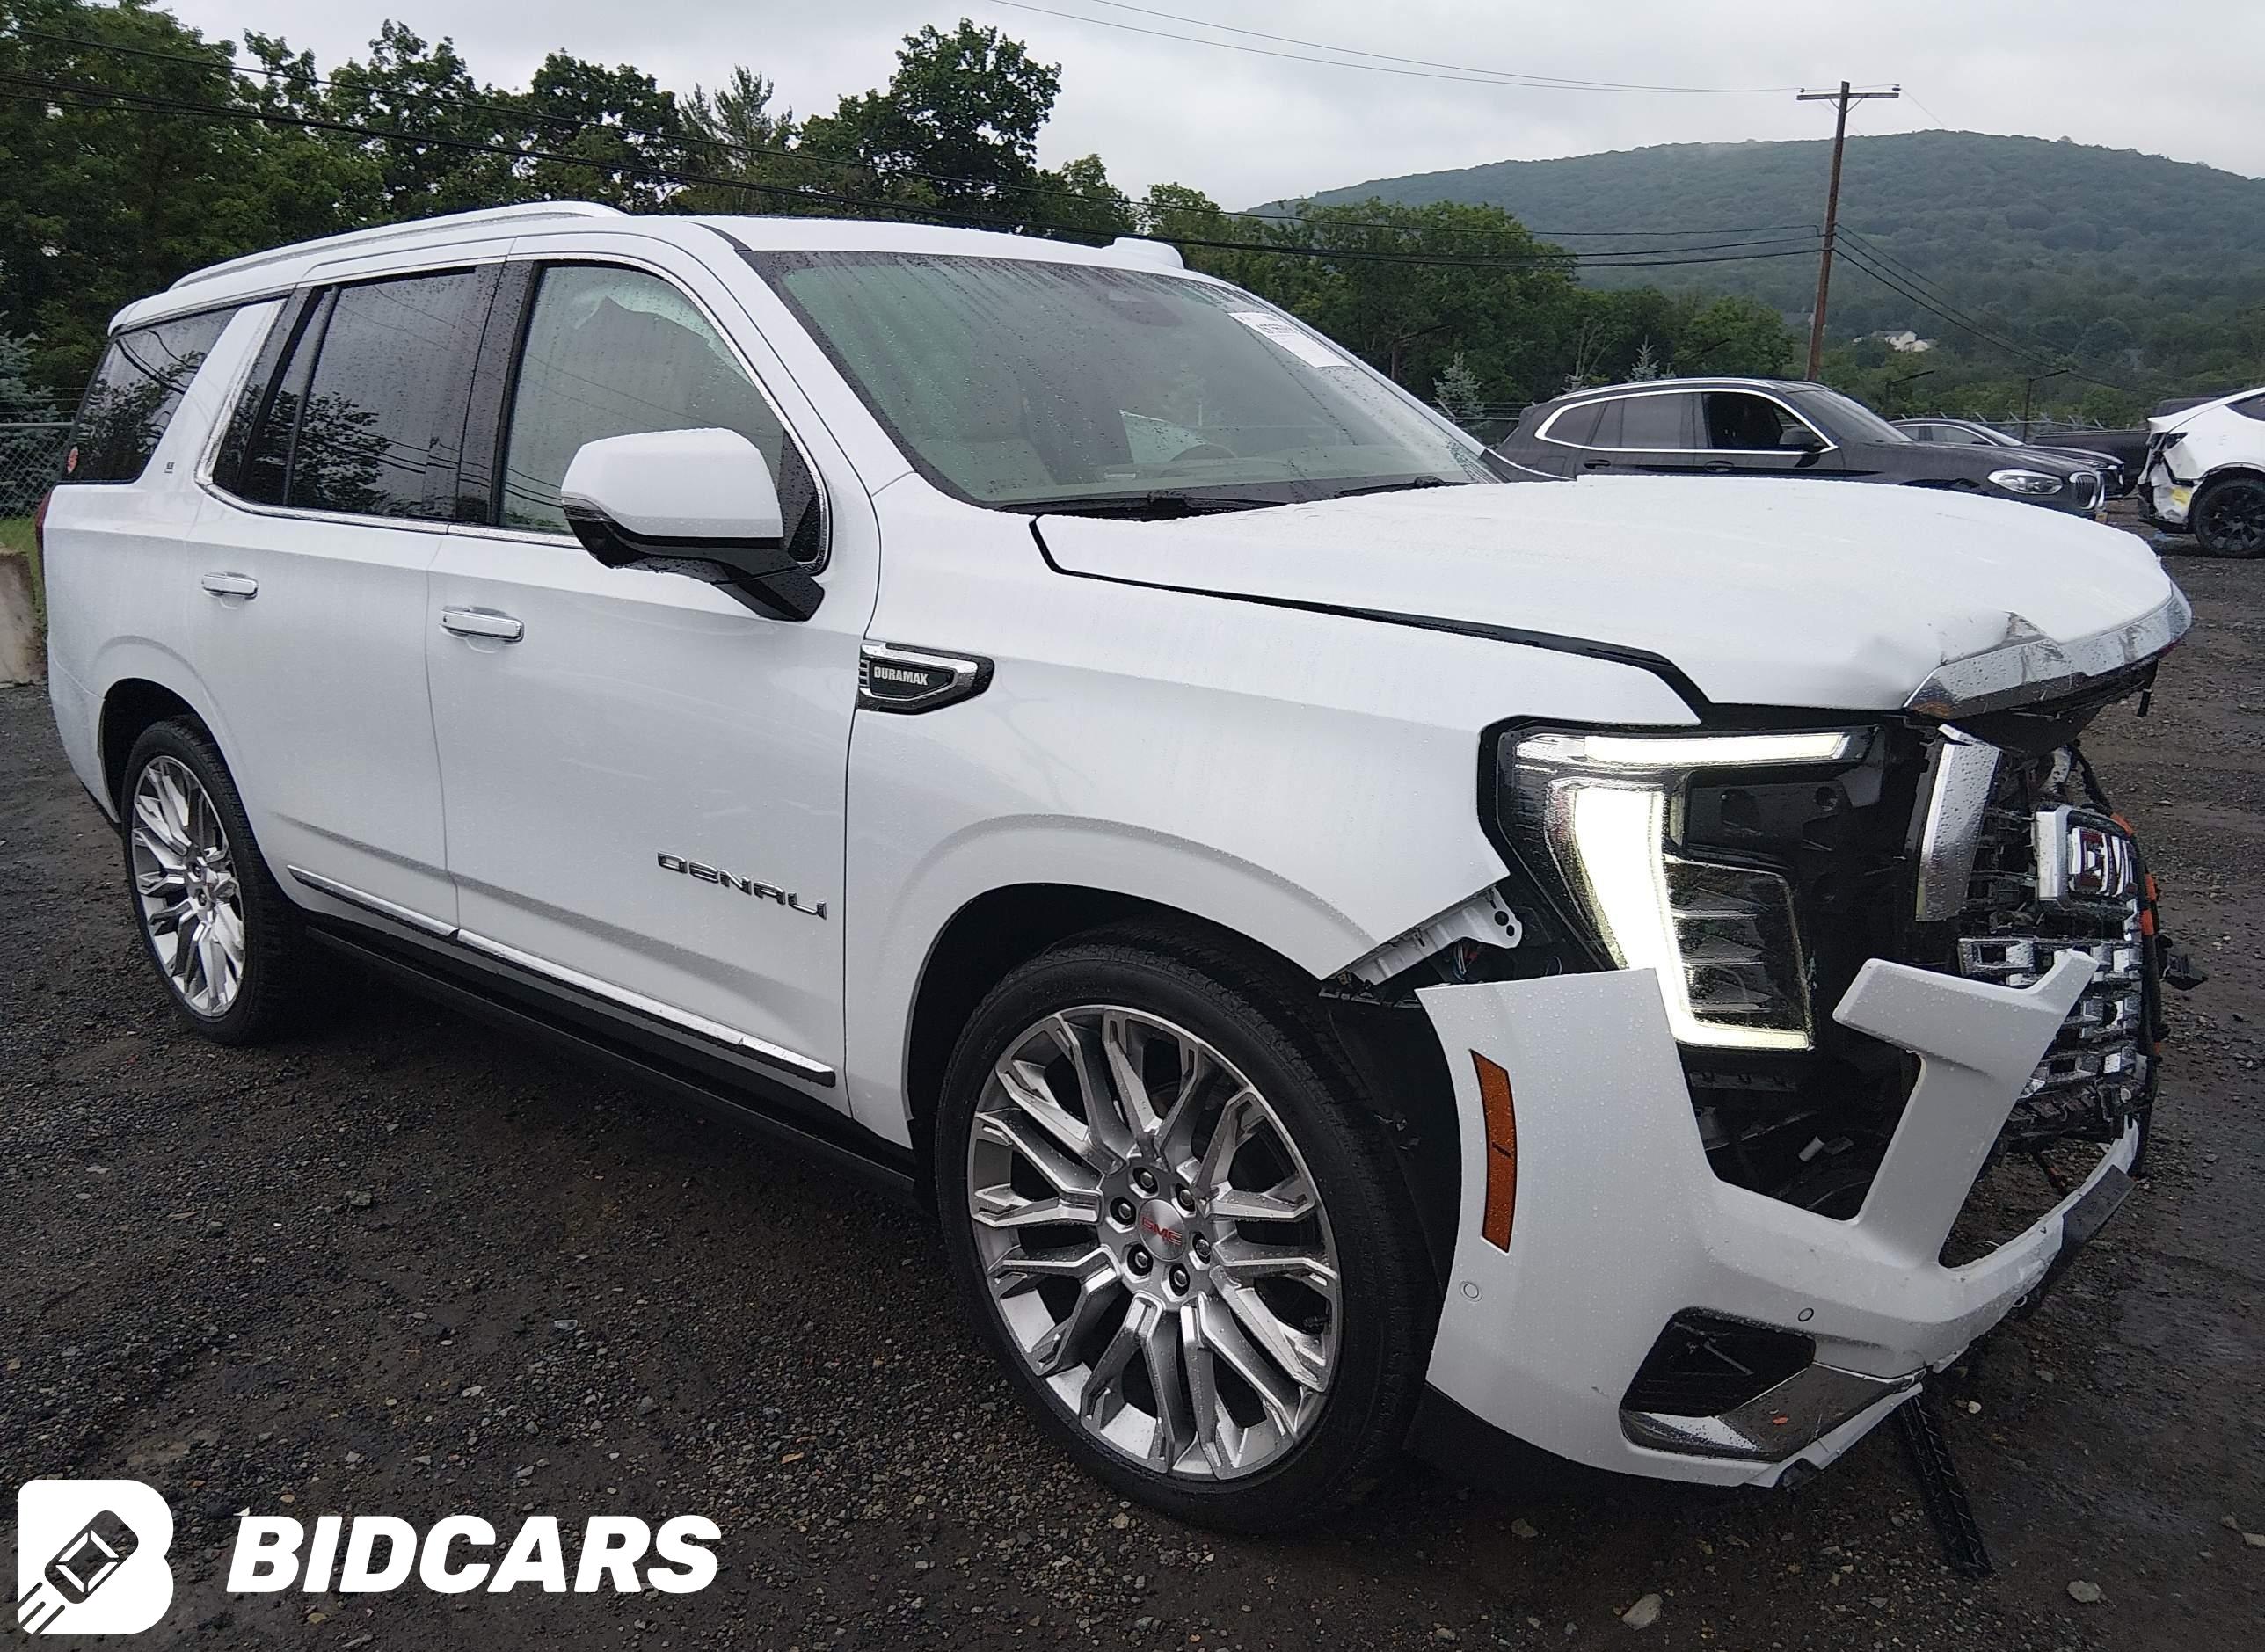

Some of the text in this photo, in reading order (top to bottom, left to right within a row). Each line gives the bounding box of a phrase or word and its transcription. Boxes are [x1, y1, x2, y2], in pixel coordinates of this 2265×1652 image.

[873, 666, 929, 686] DURAMAX
[657, 850, 827, 921] DENALI
[1140, 1215, 1183, 1247] GMC
